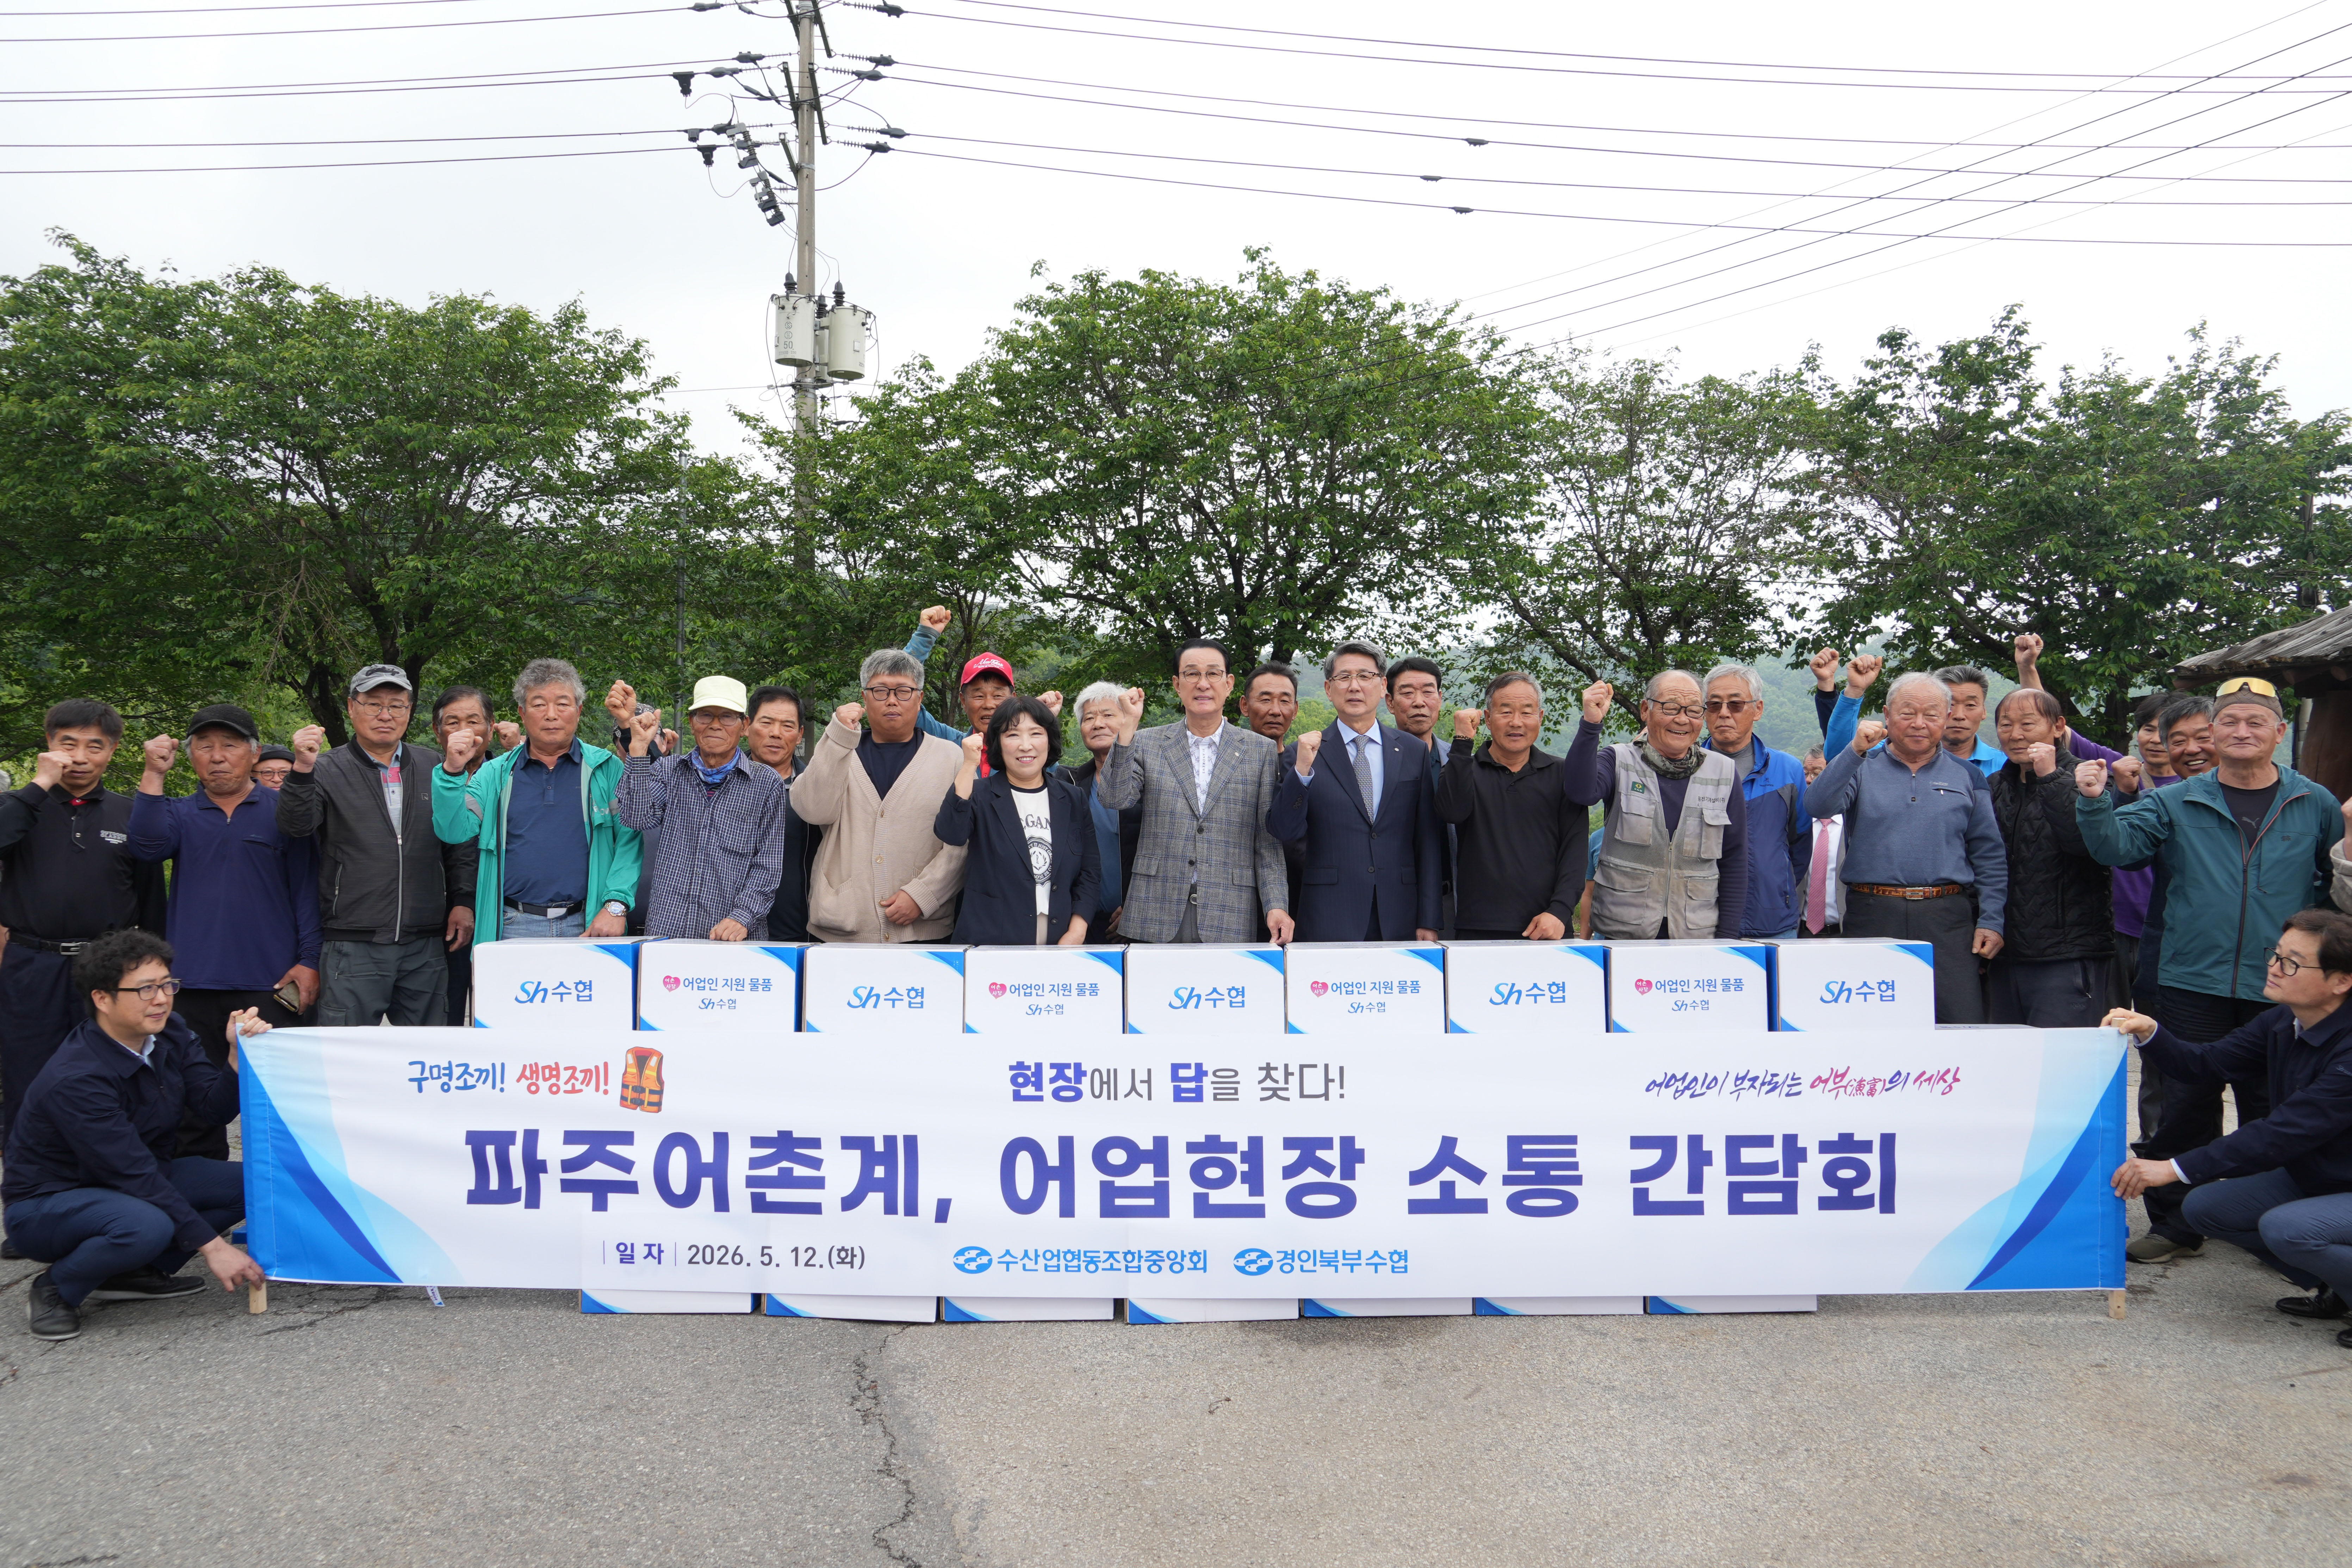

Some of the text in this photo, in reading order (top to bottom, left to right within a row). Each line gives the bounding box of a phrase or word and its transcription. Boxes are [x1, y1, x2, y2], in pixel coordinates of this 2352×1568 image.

[515, 980, 592, 1004] Sh수협
[683, 978, 773, 992] 어업인 지원 물품
[1010, 983, 1100, 997] 어업인 지원 물품
[1331, 981, 1422, 996] 어업인 지원 물품
[1489, 981, 1566, 1006] Sh수협
[1655, 979, 1745, 993] 어업인 지원 물품
[1820, 980, 1895, 1004] Sh수협
[699, 998, 737, 1010] Sh수협
[847, 986, 925, 1009] Sh수협
[1168, 986, 1246, 1010] Sh수협
[1348, 1002, 1386, 1014] Sh수협
[1672, 1000, 1709, 1012] Sh수협
[1026, 1004, 1064, 1016] Sh수협
[408, 1060, 609, 1096] 구명조끼! 생명조끼!
[1009, 1061, 1345, 1103] 현장에서 답을 찾다!
[1645, 1070, 1729, 1098] 어업인이
[1729, 1069, 1803, 1102] 부자되는
[1913, 1066, 1961, 1096] 세상
[465, 1129, 1897, 1224] 파주어촌계, 어업현장 소통 간담회
[688, 1245, 751, 1267] 2026.
[761, 1246, 780, 1268] 5.
[998, 1249, 1208, 1275] 수산업협동조합중앙회
[1277, 1249, 1409, 1275] 경인북부수협
